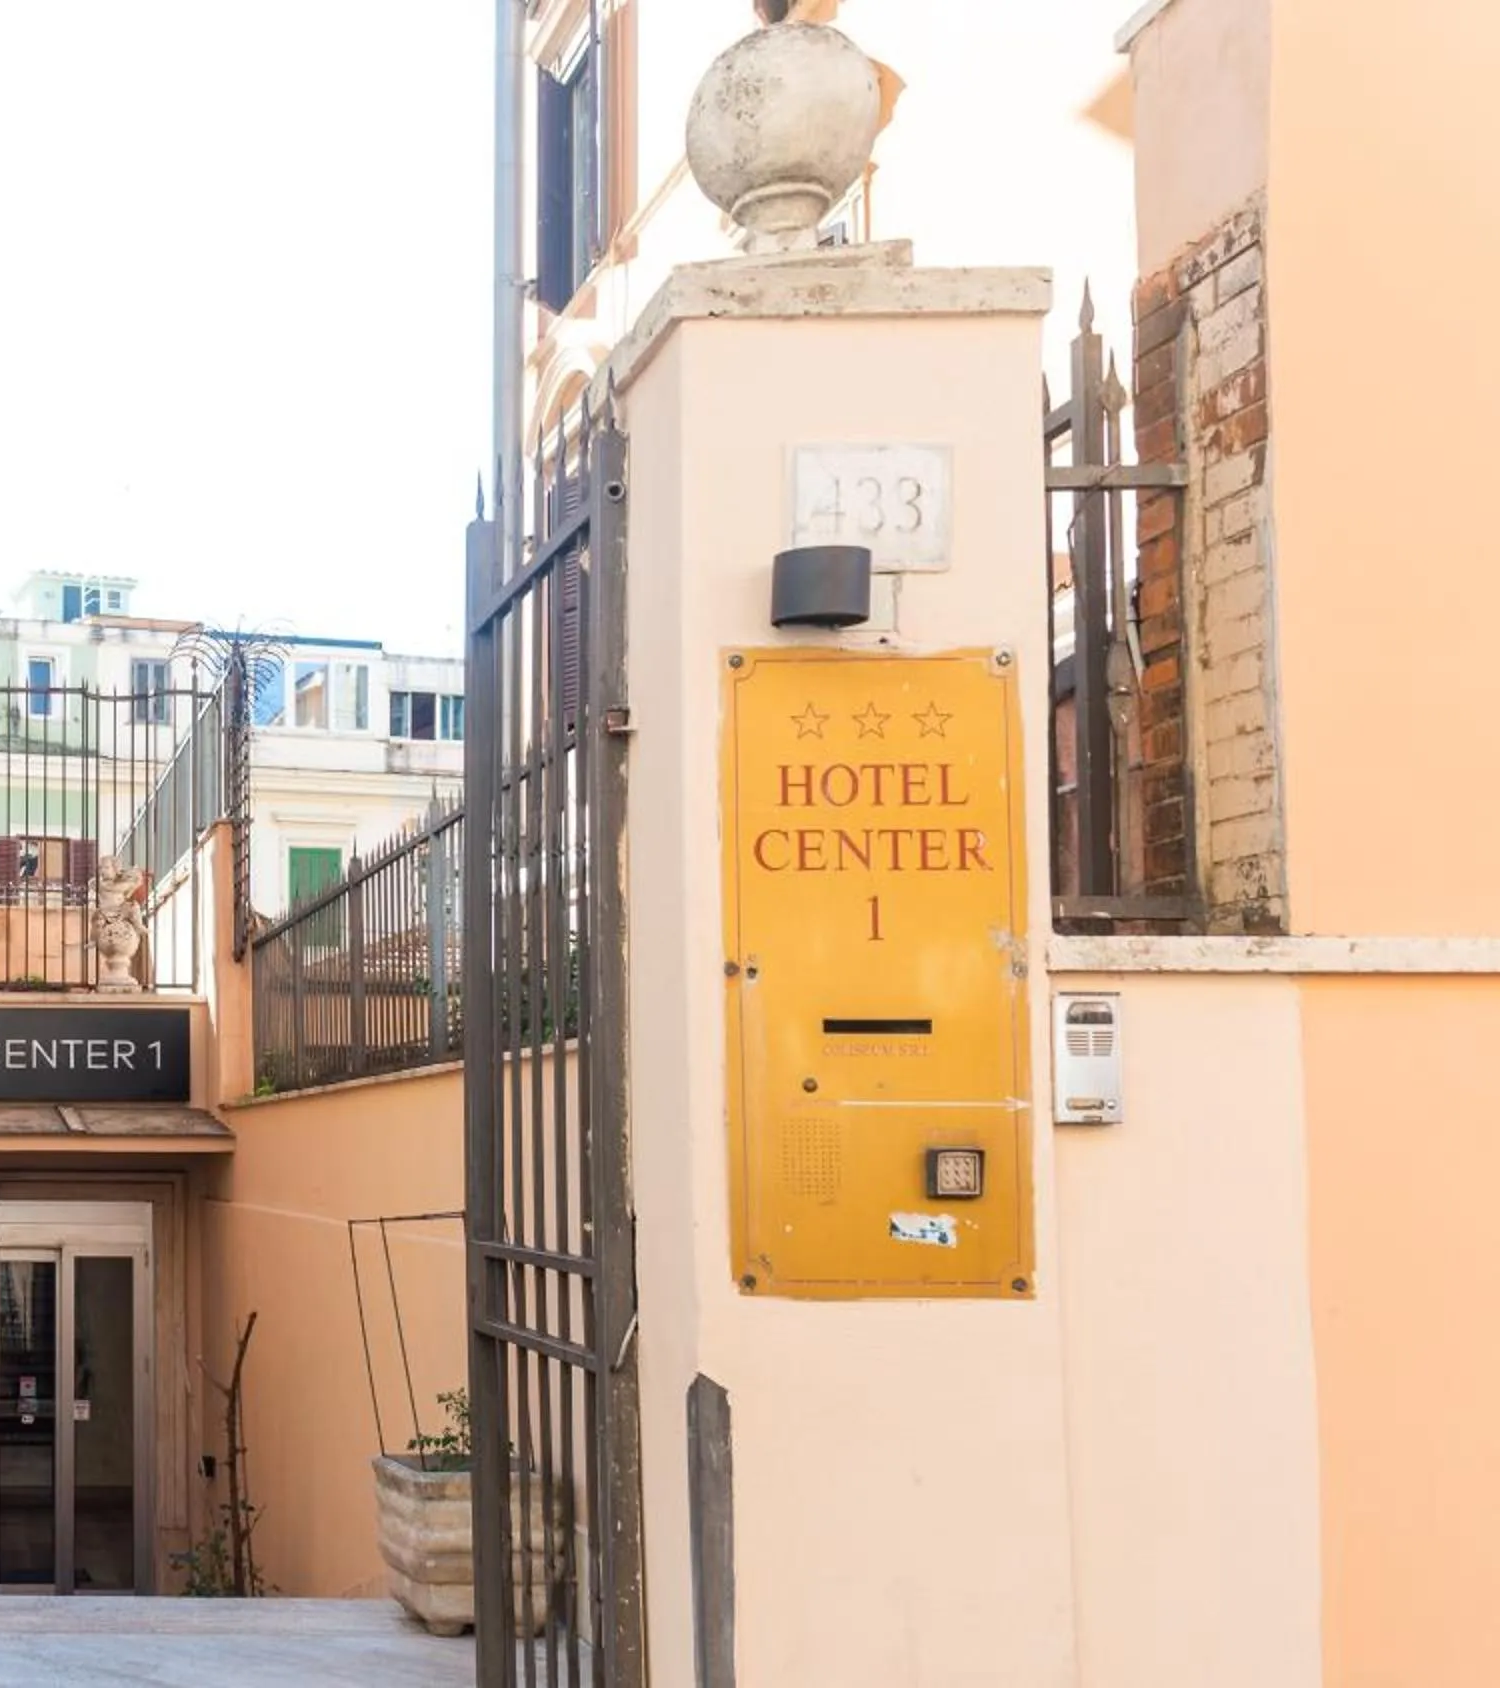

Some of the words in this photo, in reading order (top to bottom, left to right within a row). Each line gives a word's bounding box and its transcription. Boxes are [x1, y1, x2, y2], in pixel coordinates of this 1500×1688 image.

[810, 475, 923, 534] 433
[776, 763, 970, 807] HOTEL
[753, 828, 994, 871] CENTER
[867, 895, 885, 941] 1
[147, 1041, 163, 1069] 1
